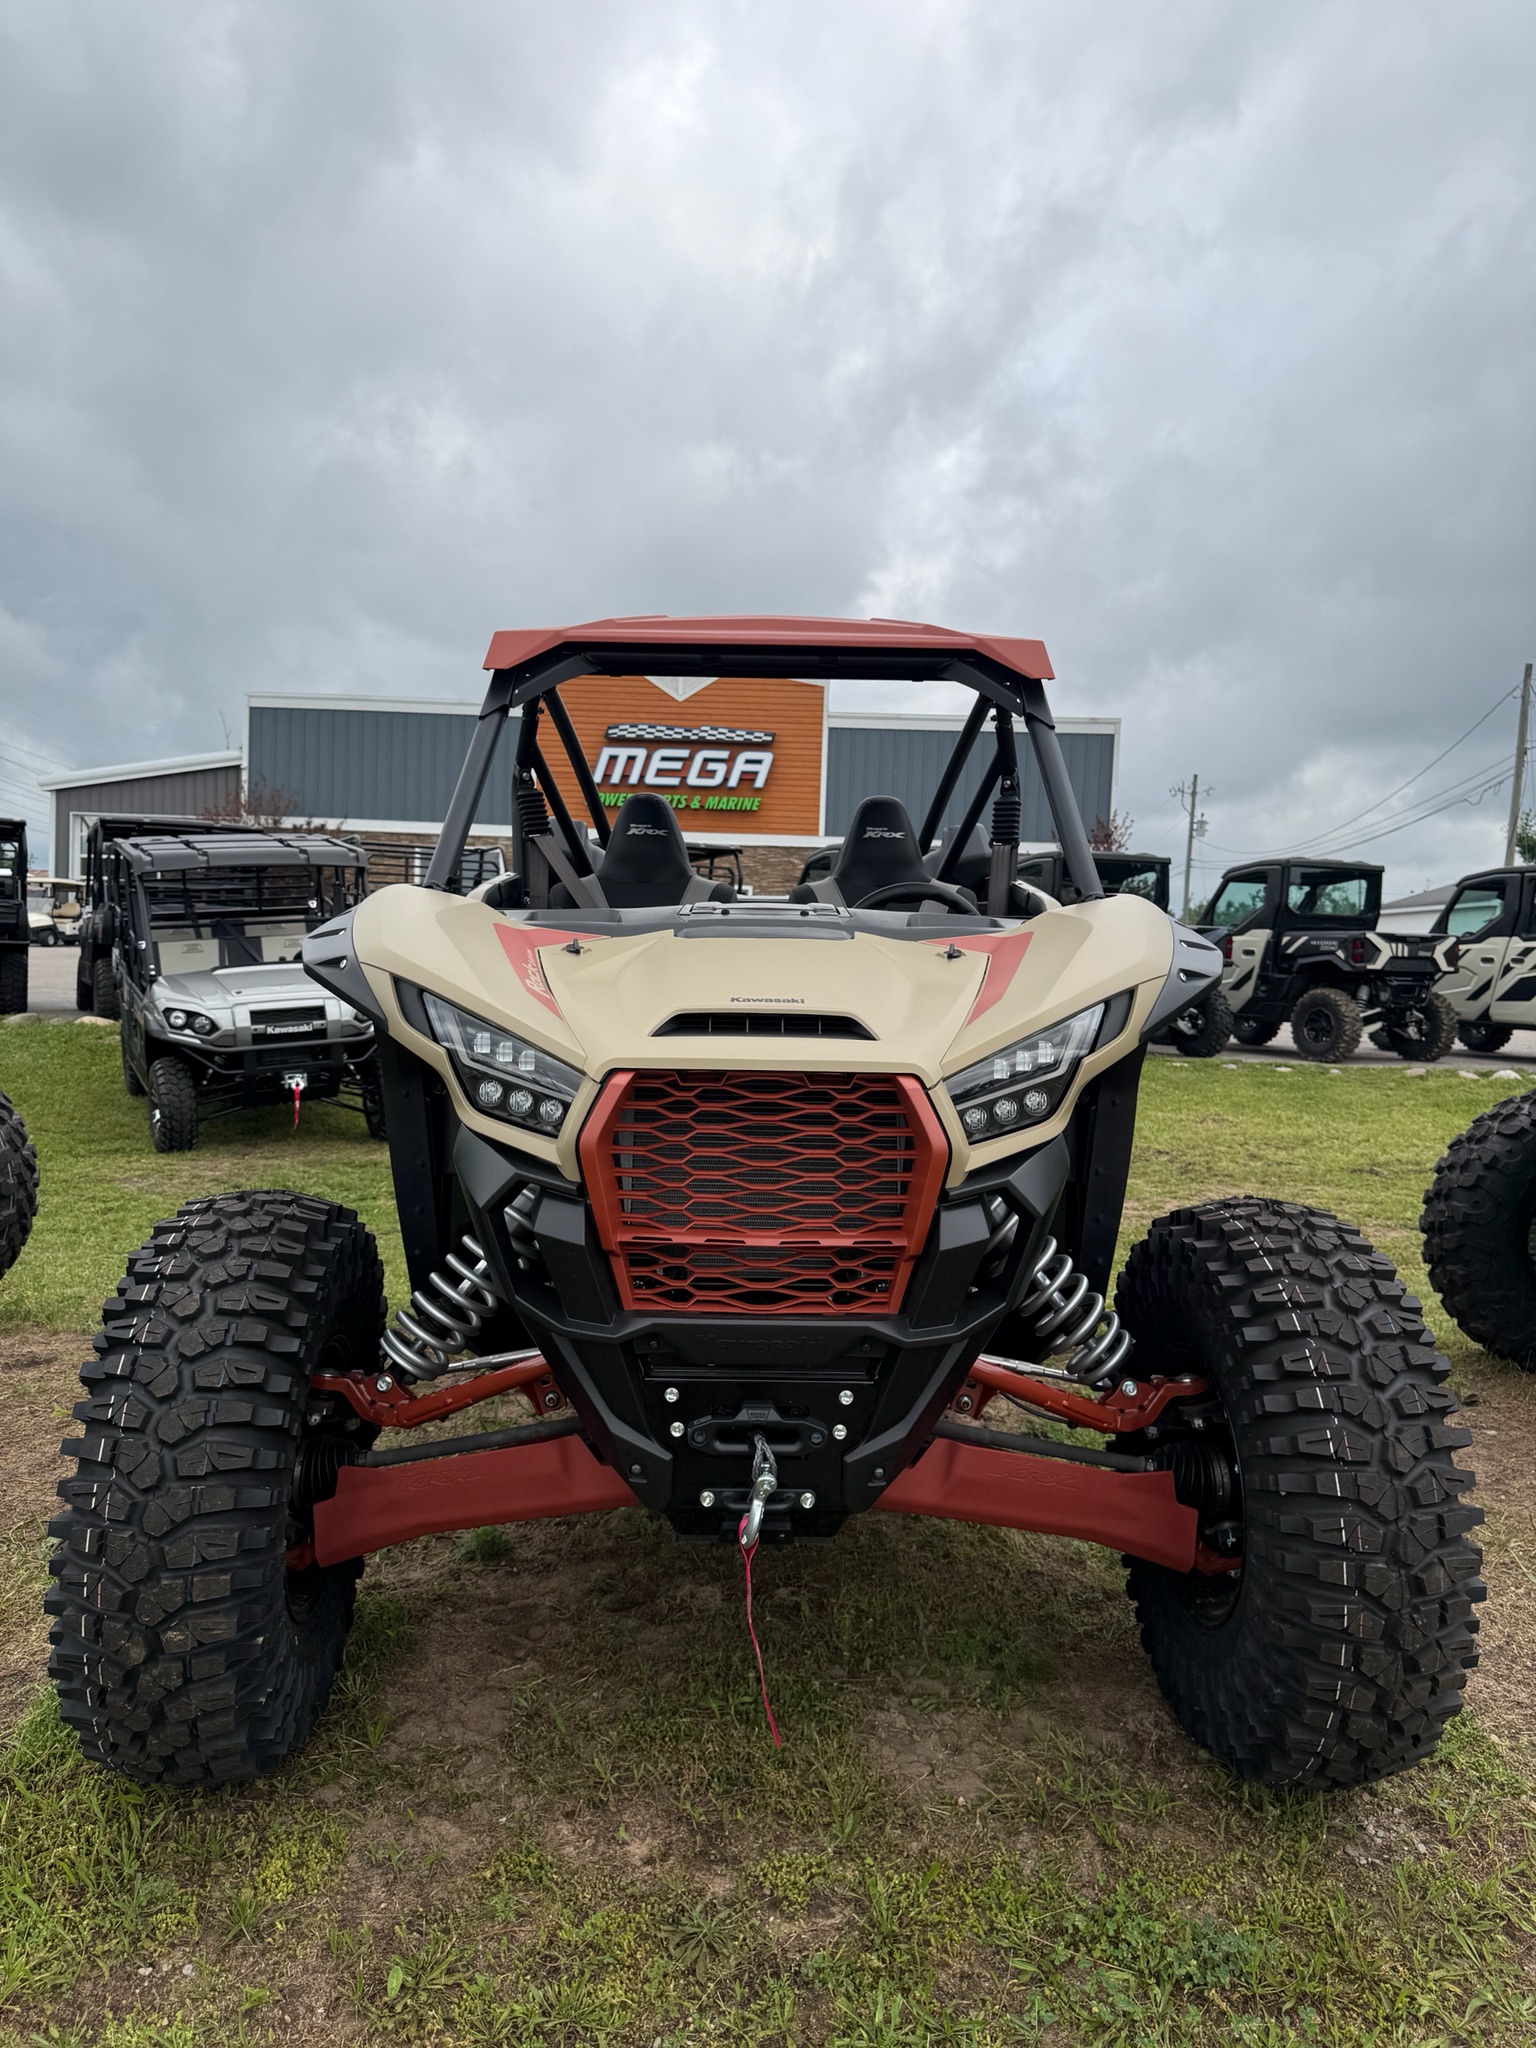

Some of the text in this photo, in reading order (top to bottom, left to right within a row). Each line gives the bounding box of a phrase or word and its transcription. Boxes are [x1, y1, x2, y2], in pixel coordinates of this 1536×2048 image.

[593, 746, 774, 789] MEGA
[690, 795, 701, 809] &
[704, 796, 762, 811] MARINE
[730, 996, 805, 1004] Kawasaki
[266, 1023, 313, 1035] Kawasaki
